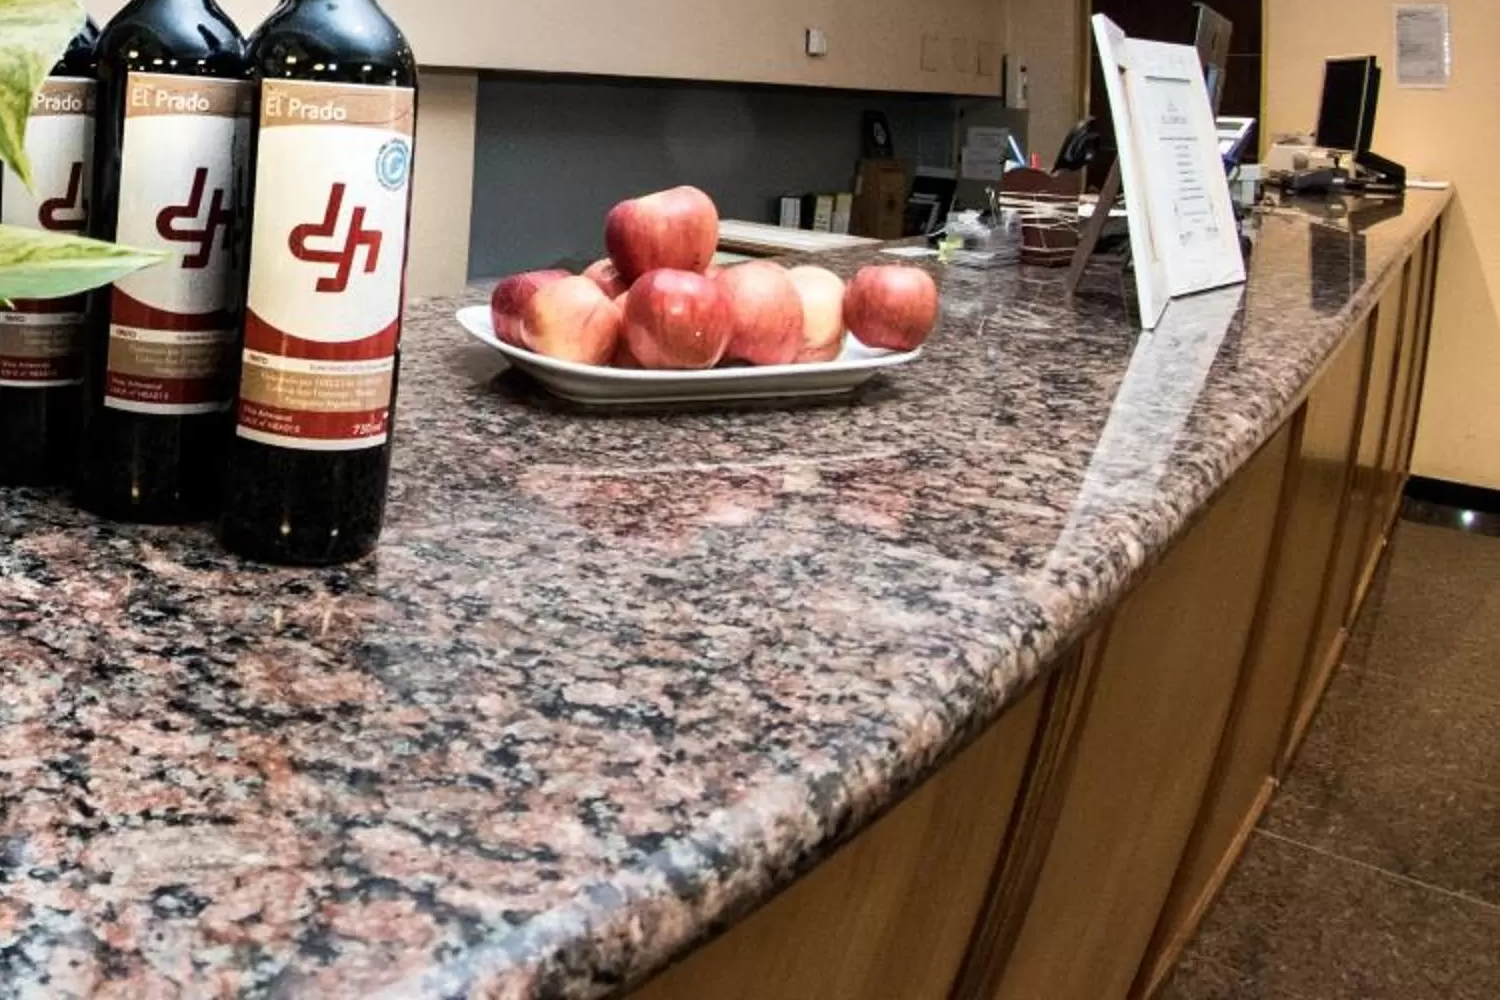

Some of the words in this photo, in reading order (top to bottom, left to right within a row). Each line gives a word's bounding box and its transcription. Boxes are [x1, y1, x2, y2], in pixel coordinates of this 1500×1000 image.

[33, 93, 84, 112] Prado
[131, 87, 150, 107] El
[155, 89, 211, 112] Prado
[265, 94, 283, 117] El
[287, 97, 348, 121] Prado
